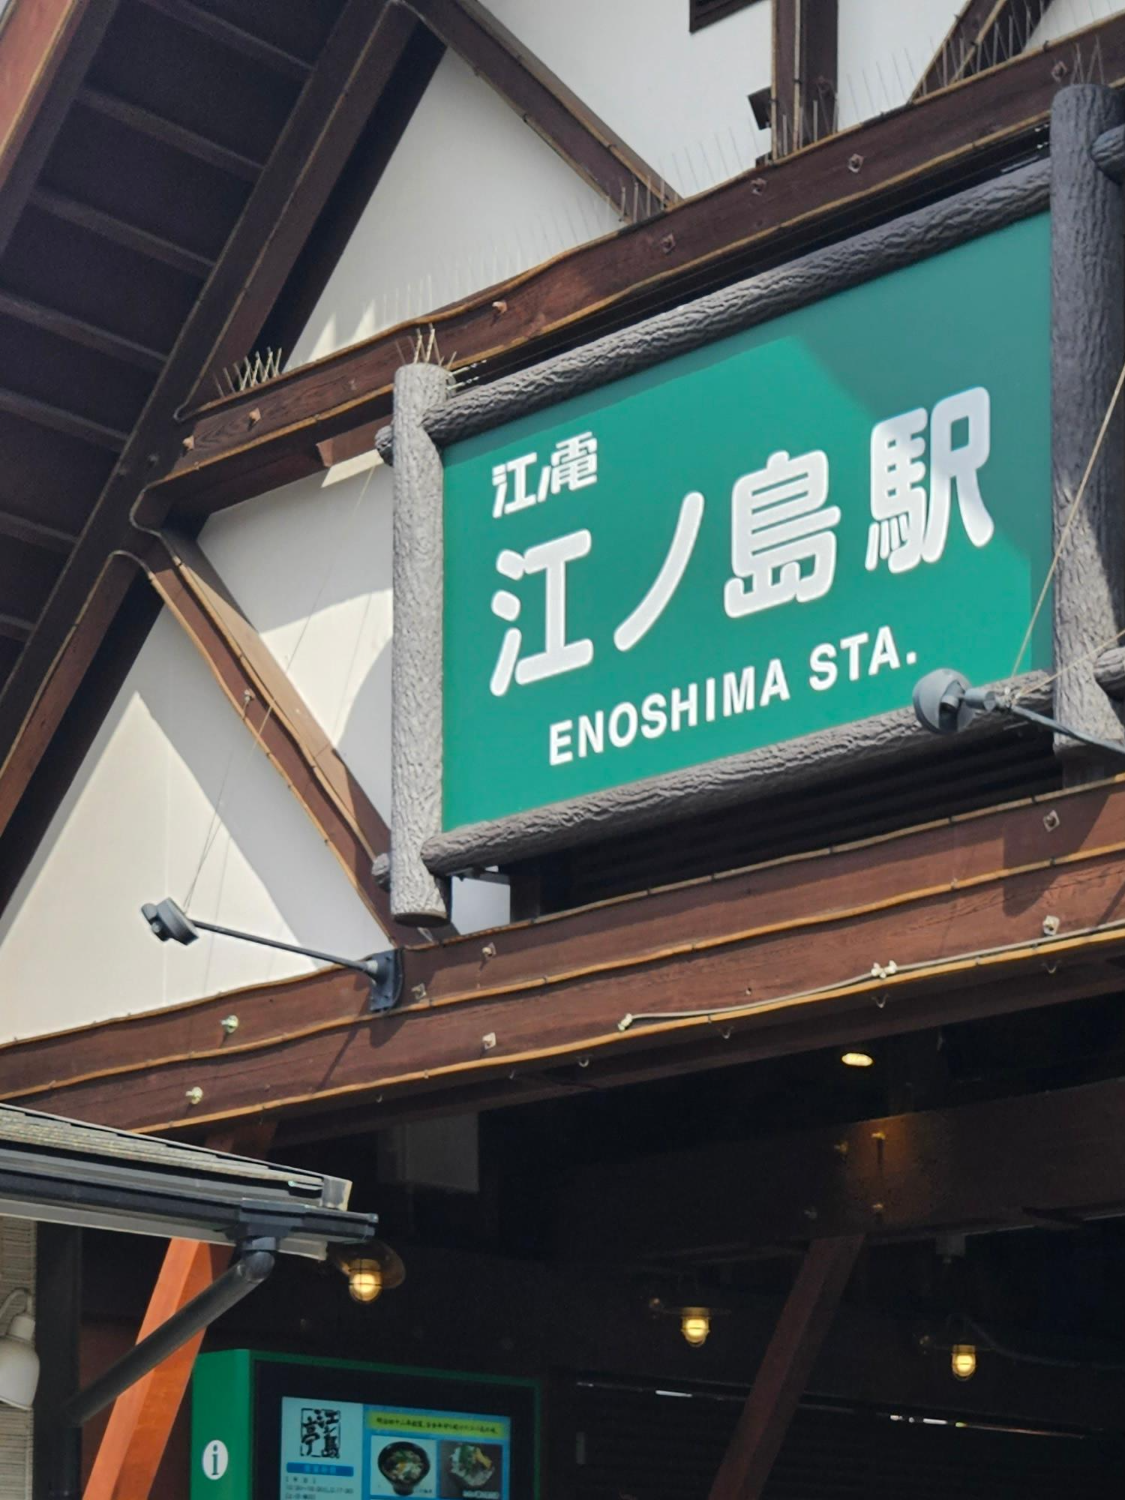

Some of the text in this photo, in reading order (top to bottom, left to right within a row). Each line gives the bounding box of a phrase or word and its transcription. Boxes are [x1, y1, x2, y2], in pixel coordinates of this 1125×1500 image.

[489, 386, 995, 697] 江ノ島駅
[548, 625, 919, 767] ENOSHIMA STA.
